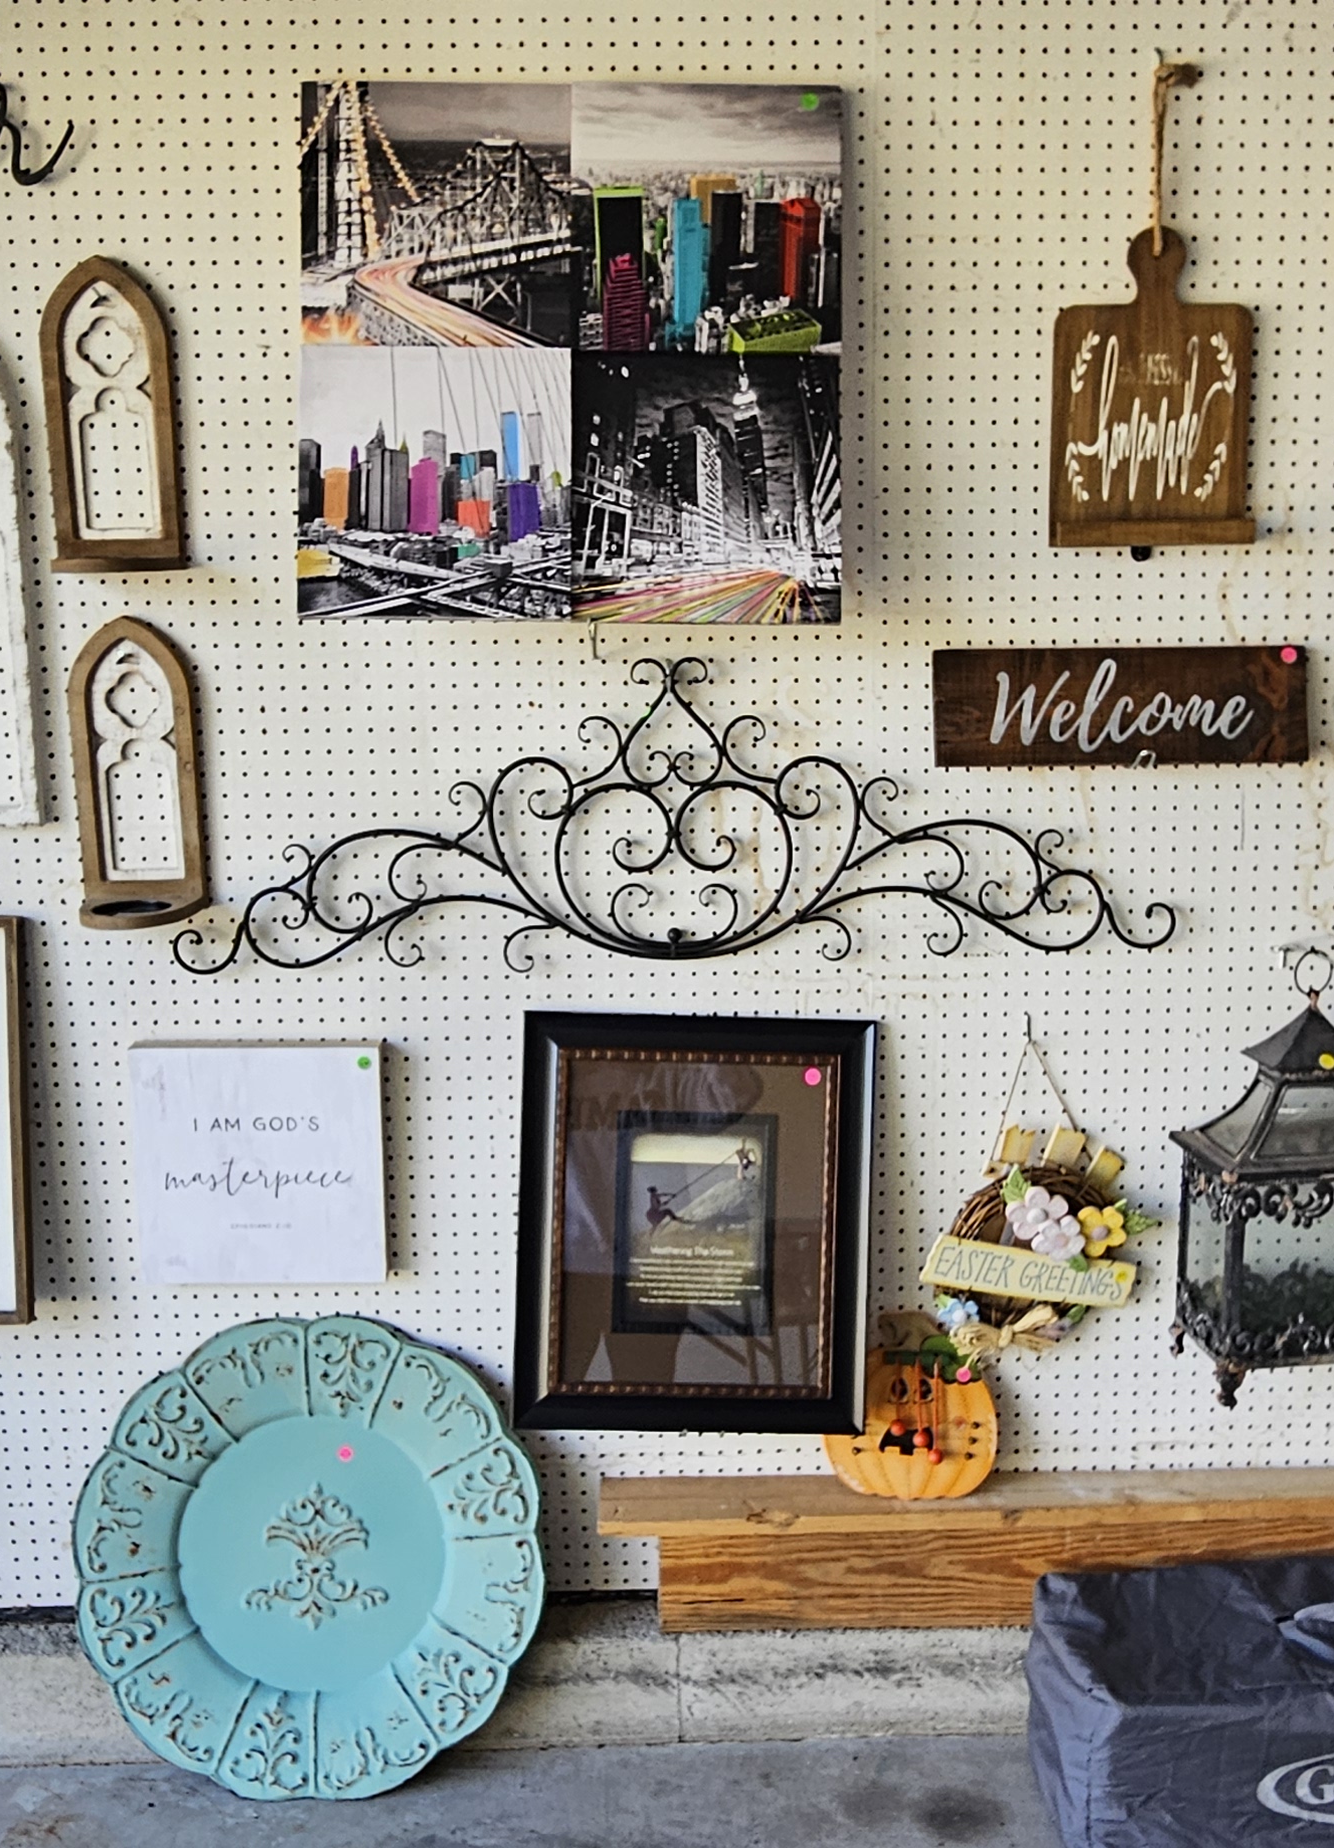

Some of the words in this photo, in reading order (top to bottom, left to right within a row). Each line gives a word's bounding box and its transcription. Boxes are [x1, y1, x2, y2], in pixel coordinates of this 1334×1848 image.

[989, 658, 1255, 754] Welcome
[193, 1117, 198, 1132] I
[210, 1117, 241, 1132] AM
[253, 1116, 320, 1132] GOD'S
[165, 1156, 352, 1199] masterpiece
[933, 1245, 1015, 1290] EASTER
[1019, 1259, 1123, 1301] GREETINGS
